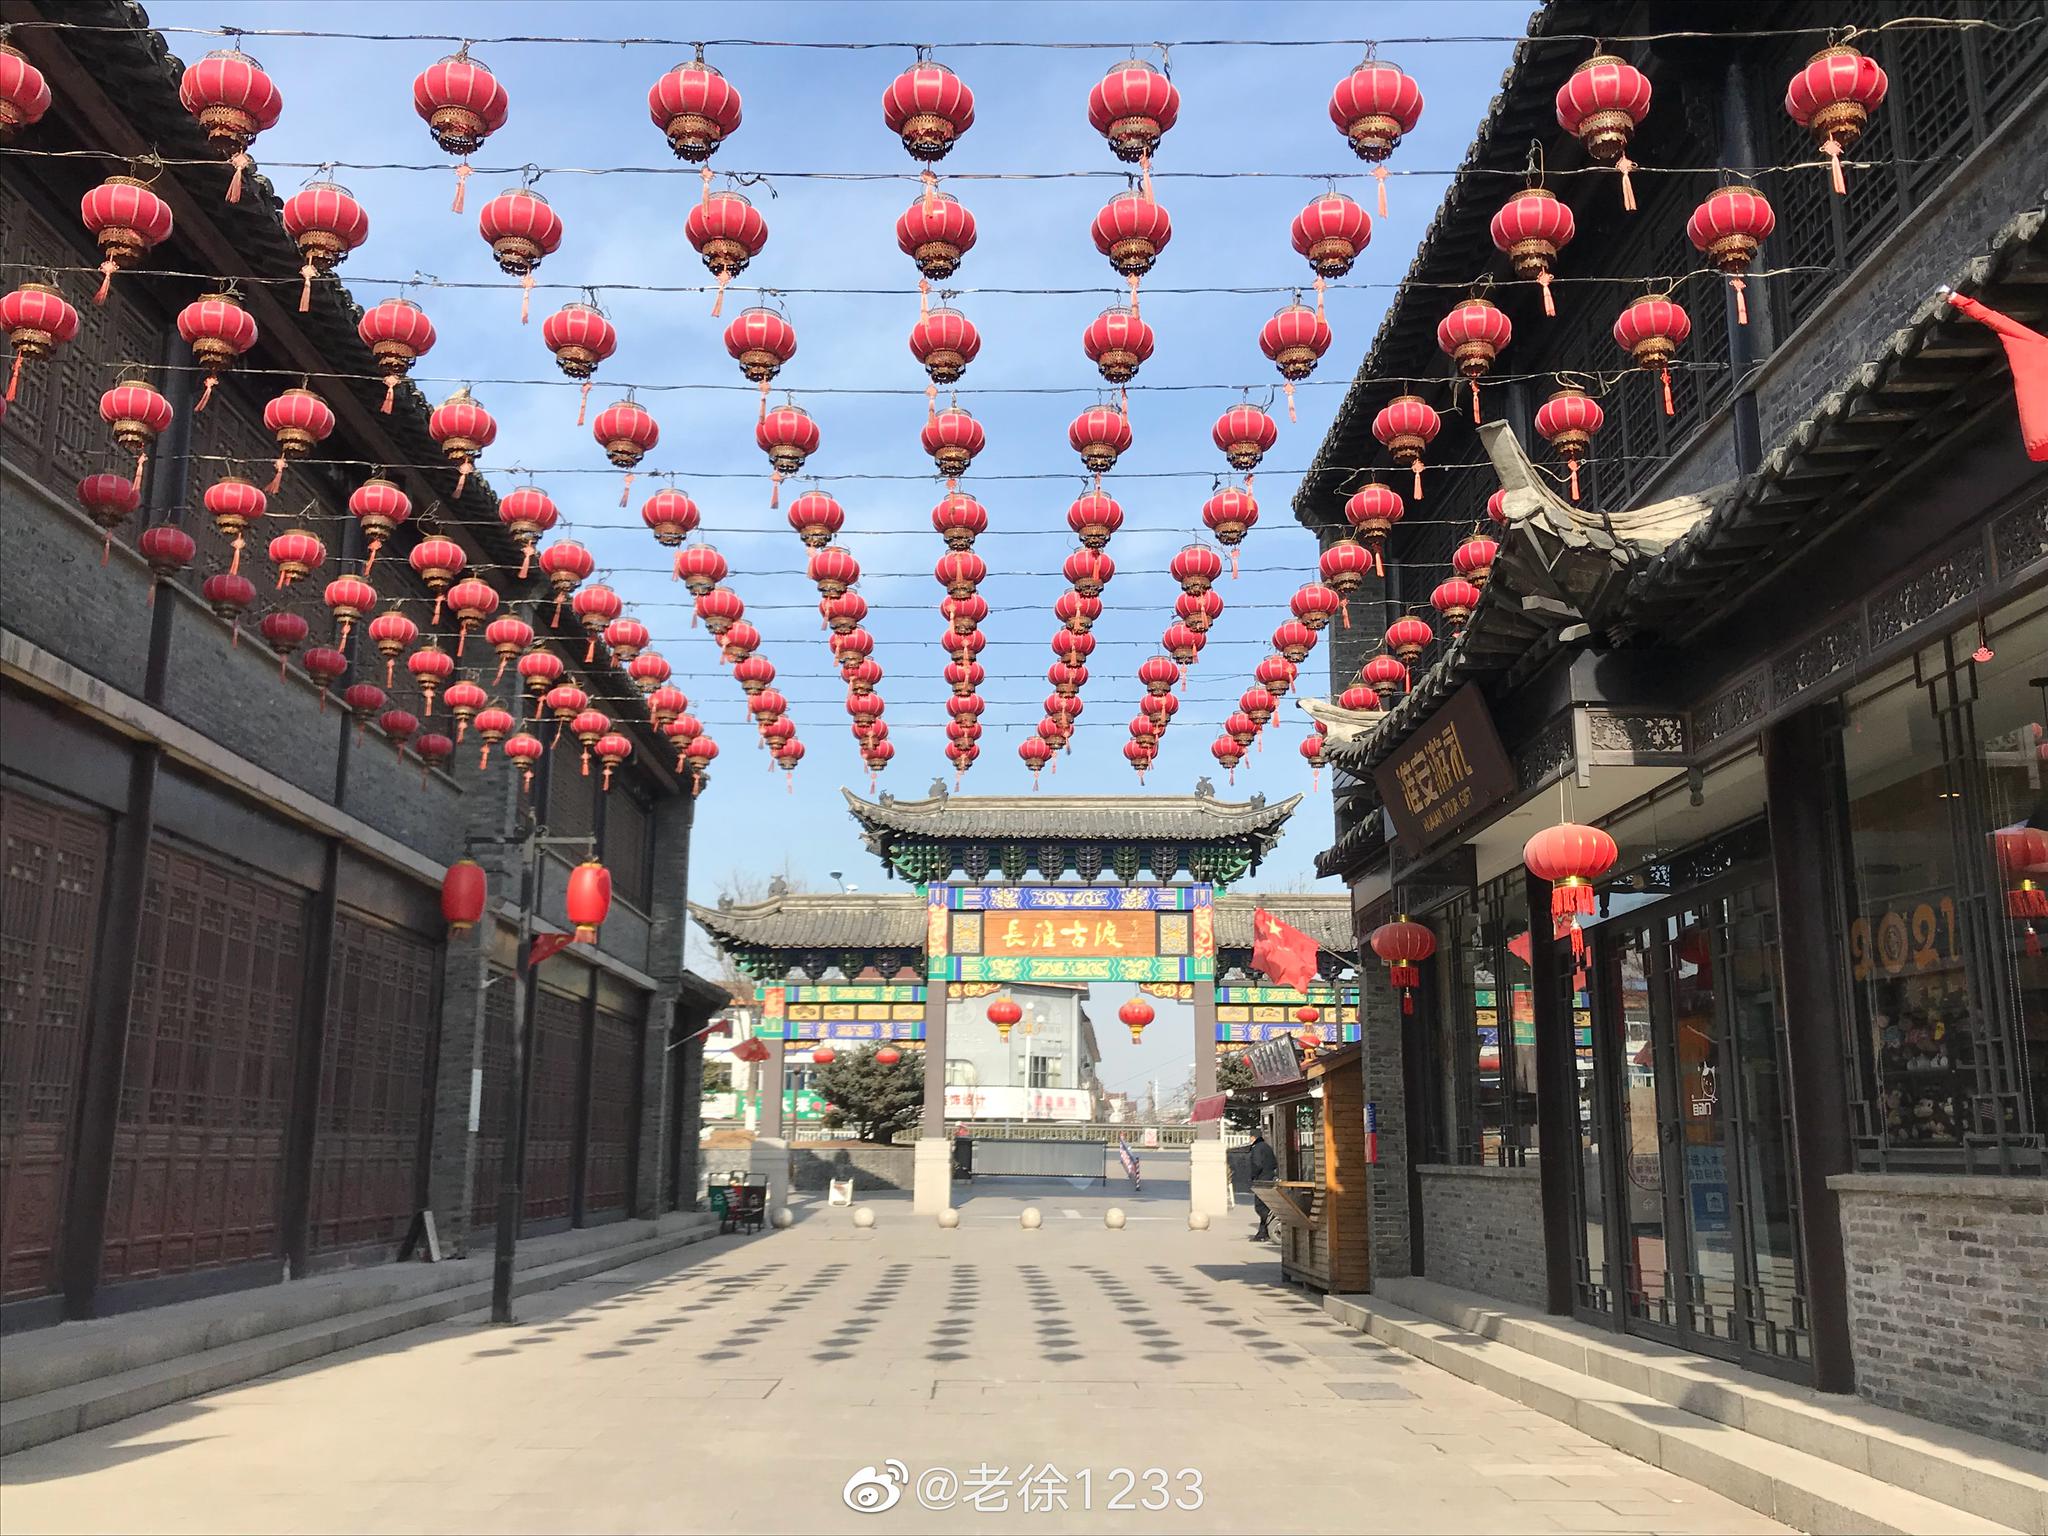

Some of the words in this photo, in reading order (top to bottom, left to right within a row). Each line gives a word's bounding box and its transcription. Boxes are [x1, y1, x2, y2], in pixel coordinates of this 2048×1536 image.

[1395, 720, 1473, 816] 淮安游礼
[1441, 797, 1461, 819] TOUR
[1458, 786, 1472, 808] GIFT
[1851, 896, 1960, 981] 2021
